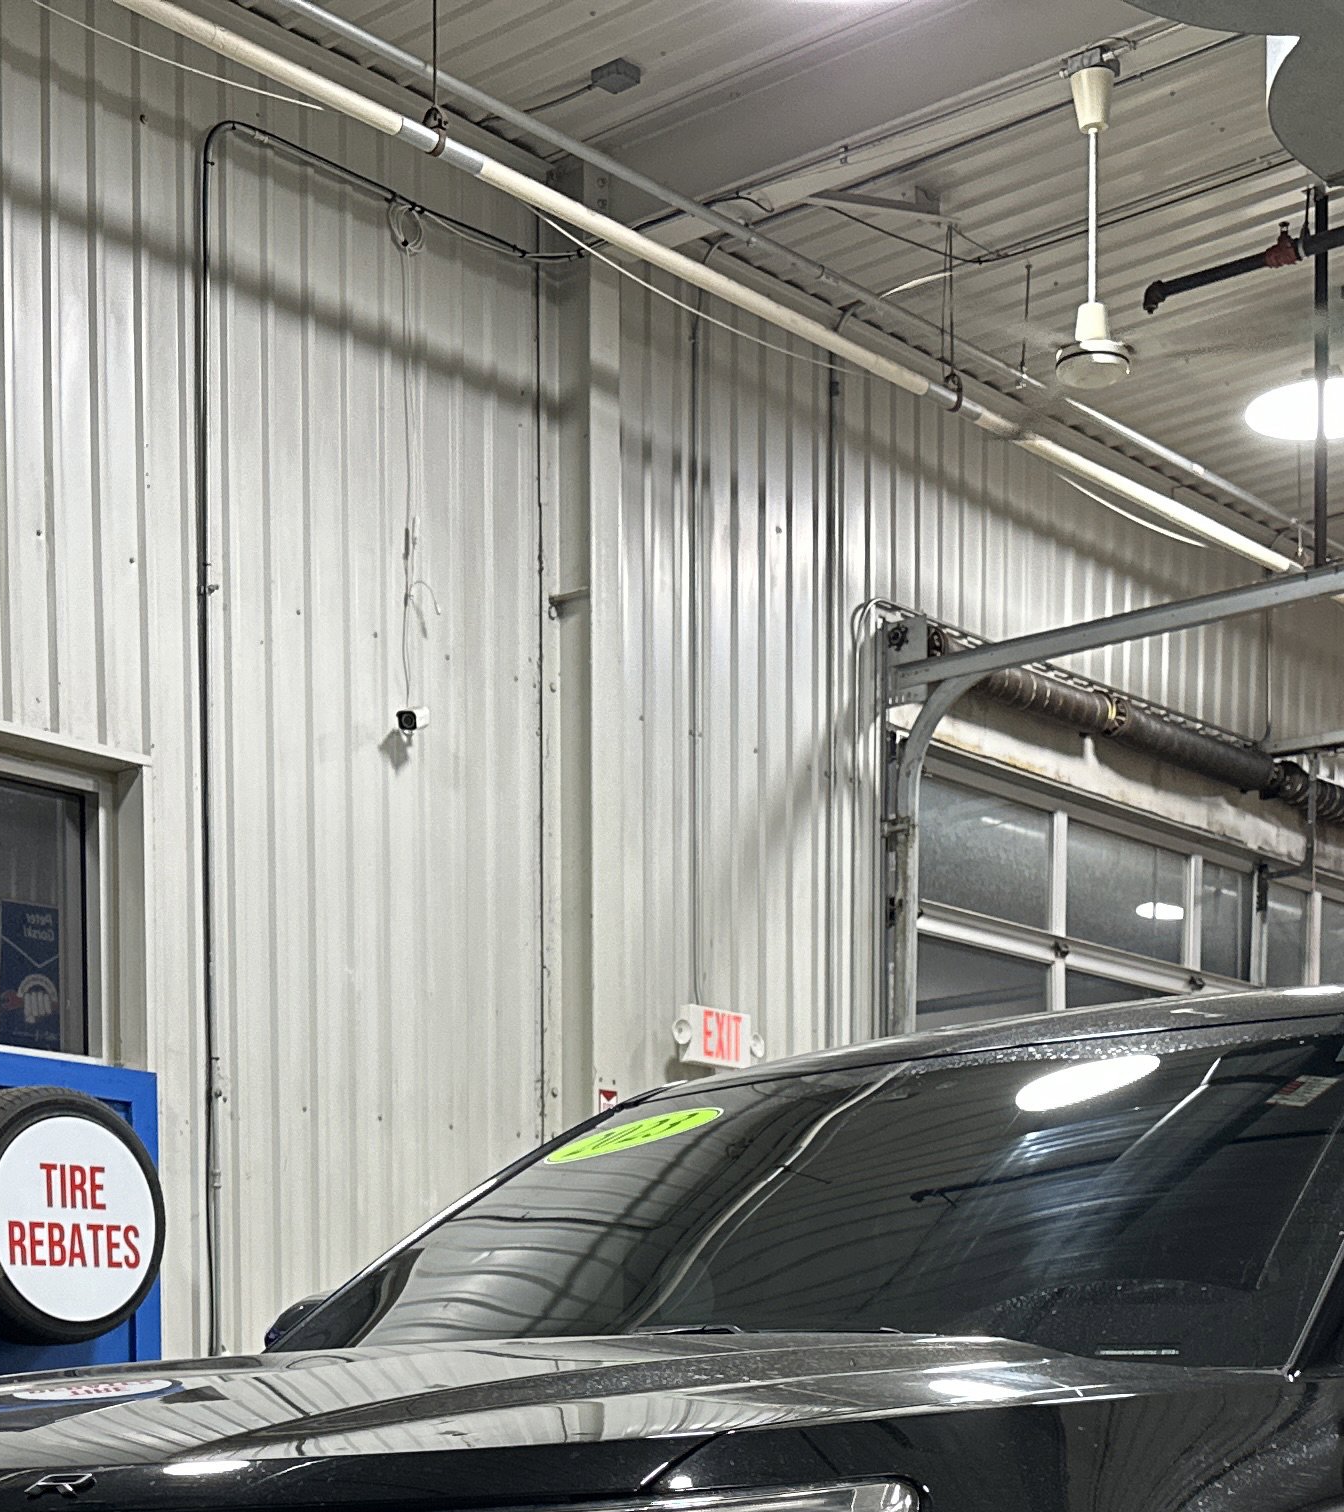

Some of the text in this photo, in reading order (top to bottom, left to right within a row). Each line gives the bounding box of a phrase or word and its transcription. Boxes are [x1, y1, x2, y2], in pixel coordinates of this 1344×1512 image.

[703, 1009, 743, 1063] EXIT
[39, 1162, 107, 1211] TIRE
[8, 1220, 141, 1270] REBATES
